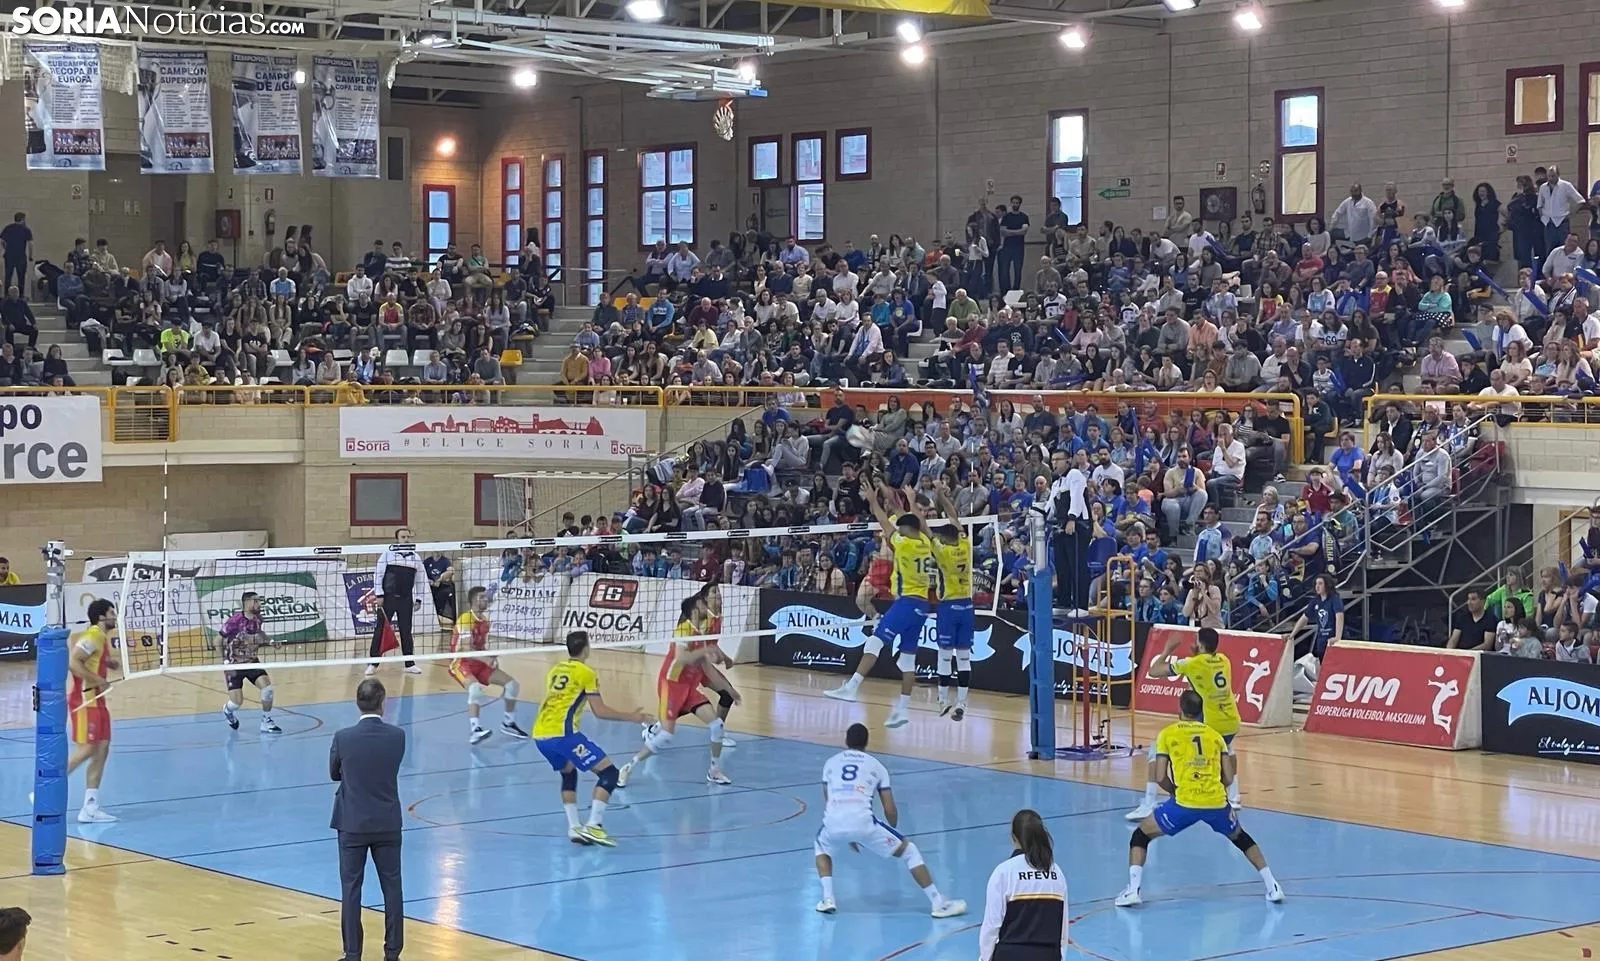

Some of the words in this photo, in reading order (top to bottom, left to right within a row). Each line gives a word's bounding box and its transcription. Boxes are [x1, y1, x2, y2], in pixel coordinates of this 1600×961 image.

[233, 54, 272, 63] TEMPORA
[50, 67, 85, 75] RECOPA
[58, 75, 92, 83] EUROPA
[160, 76, 207, 84] SUPERCOPA
[256, 81, 273, 92] DE
[354, 84, 364, 92] DEL
[357, 440, 390, 452] Soria
[528, 438, 600, 449] SORIA
[4, 441, 88, 479] rce
[957, 563, 967, 572] 7
[346, 580, 357, 590] LA
[207, 601, 319, 619] PRNCIÓN
[563, 610, 644, 632] INSOCA
[549, 674, 569, 690] 13
[1214, 671, 1227, 688] 6
[1139, 684, 1173, 697] SUPERLIGA
[1320, 673, 1401, 706] SVM
[1314, 704, 1352, 718] SUPERLIGA
[1352, 708, 1386, 722] VOLEIBOL
[1385, 712, 1426, 726] MASCULINA
[1192, 735, 1203, 756] 1
[841, 764, 859, 782] 8
[1018, 871, 1058, 880] RFEVB
